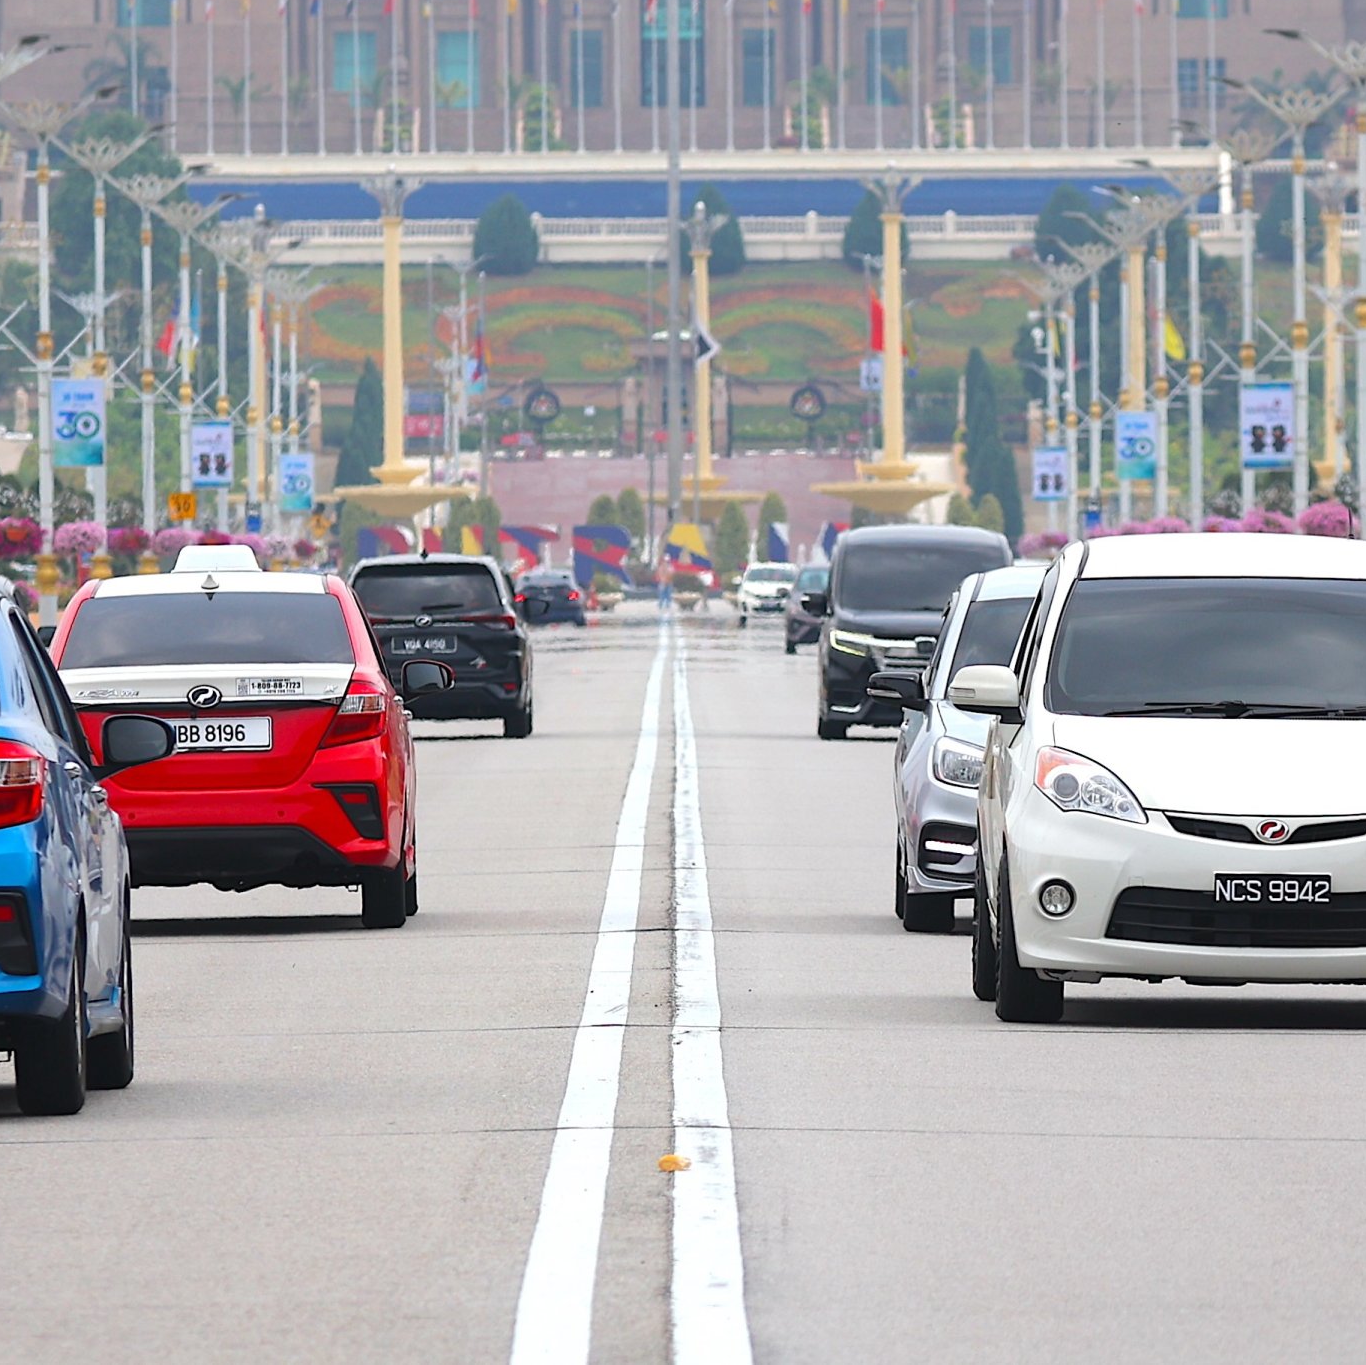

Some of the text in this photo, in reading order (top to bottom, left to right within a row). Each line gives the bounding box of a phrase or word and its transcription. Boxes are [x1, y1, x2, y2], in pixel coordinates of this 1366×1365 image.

[174, 724, 246, 743] BB 8196
[1215, 879, 1330, 902] NCS 9942
